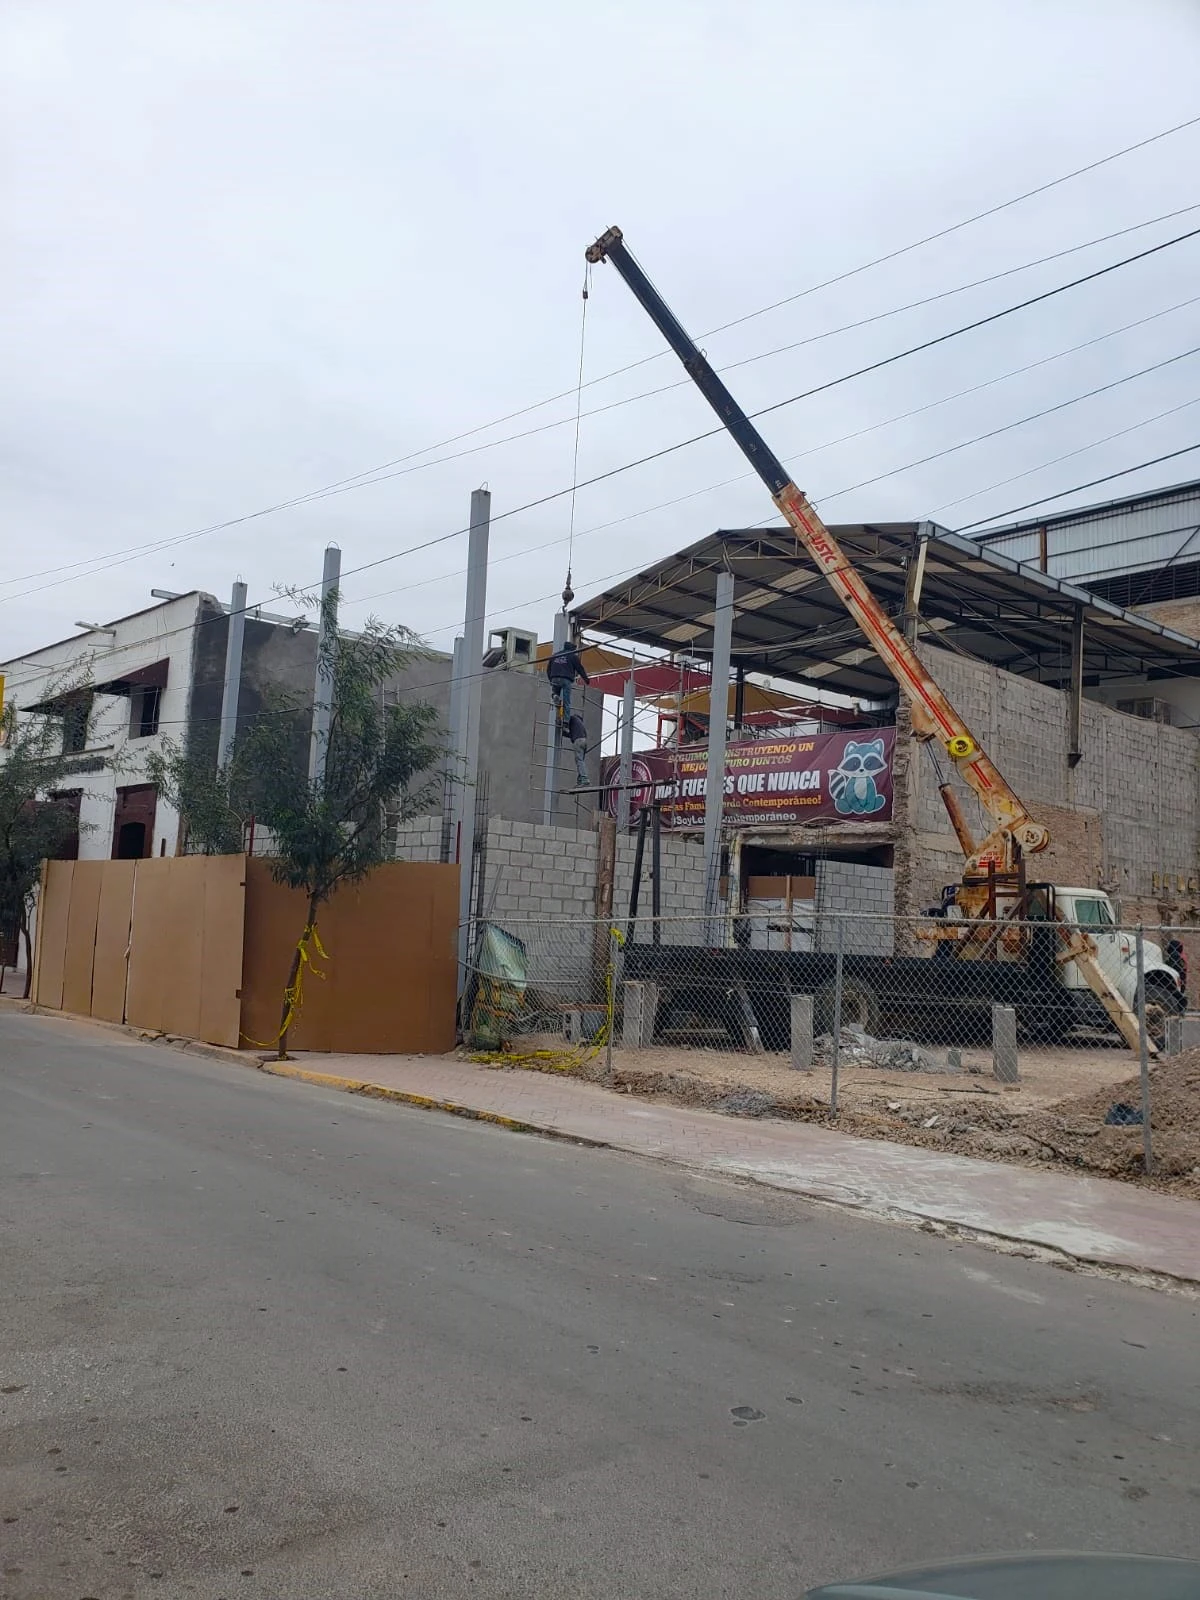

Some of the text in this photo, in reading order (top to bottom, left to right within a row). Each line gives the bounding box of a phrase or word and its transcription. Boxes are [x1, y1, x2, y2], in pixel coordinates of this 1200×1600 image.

[724, 744, 796, 758] NSTRUYENDO
[798, 742, 816, 752] UN
[681, 762, 708, 773] MEJO
[751, 755, 793, 768] JUNTOS
[737, 774, 765, 795] QUE
[767, 770, 821, 792] NUNCA
[743, 795, 822, 808] Contemporáneo!
